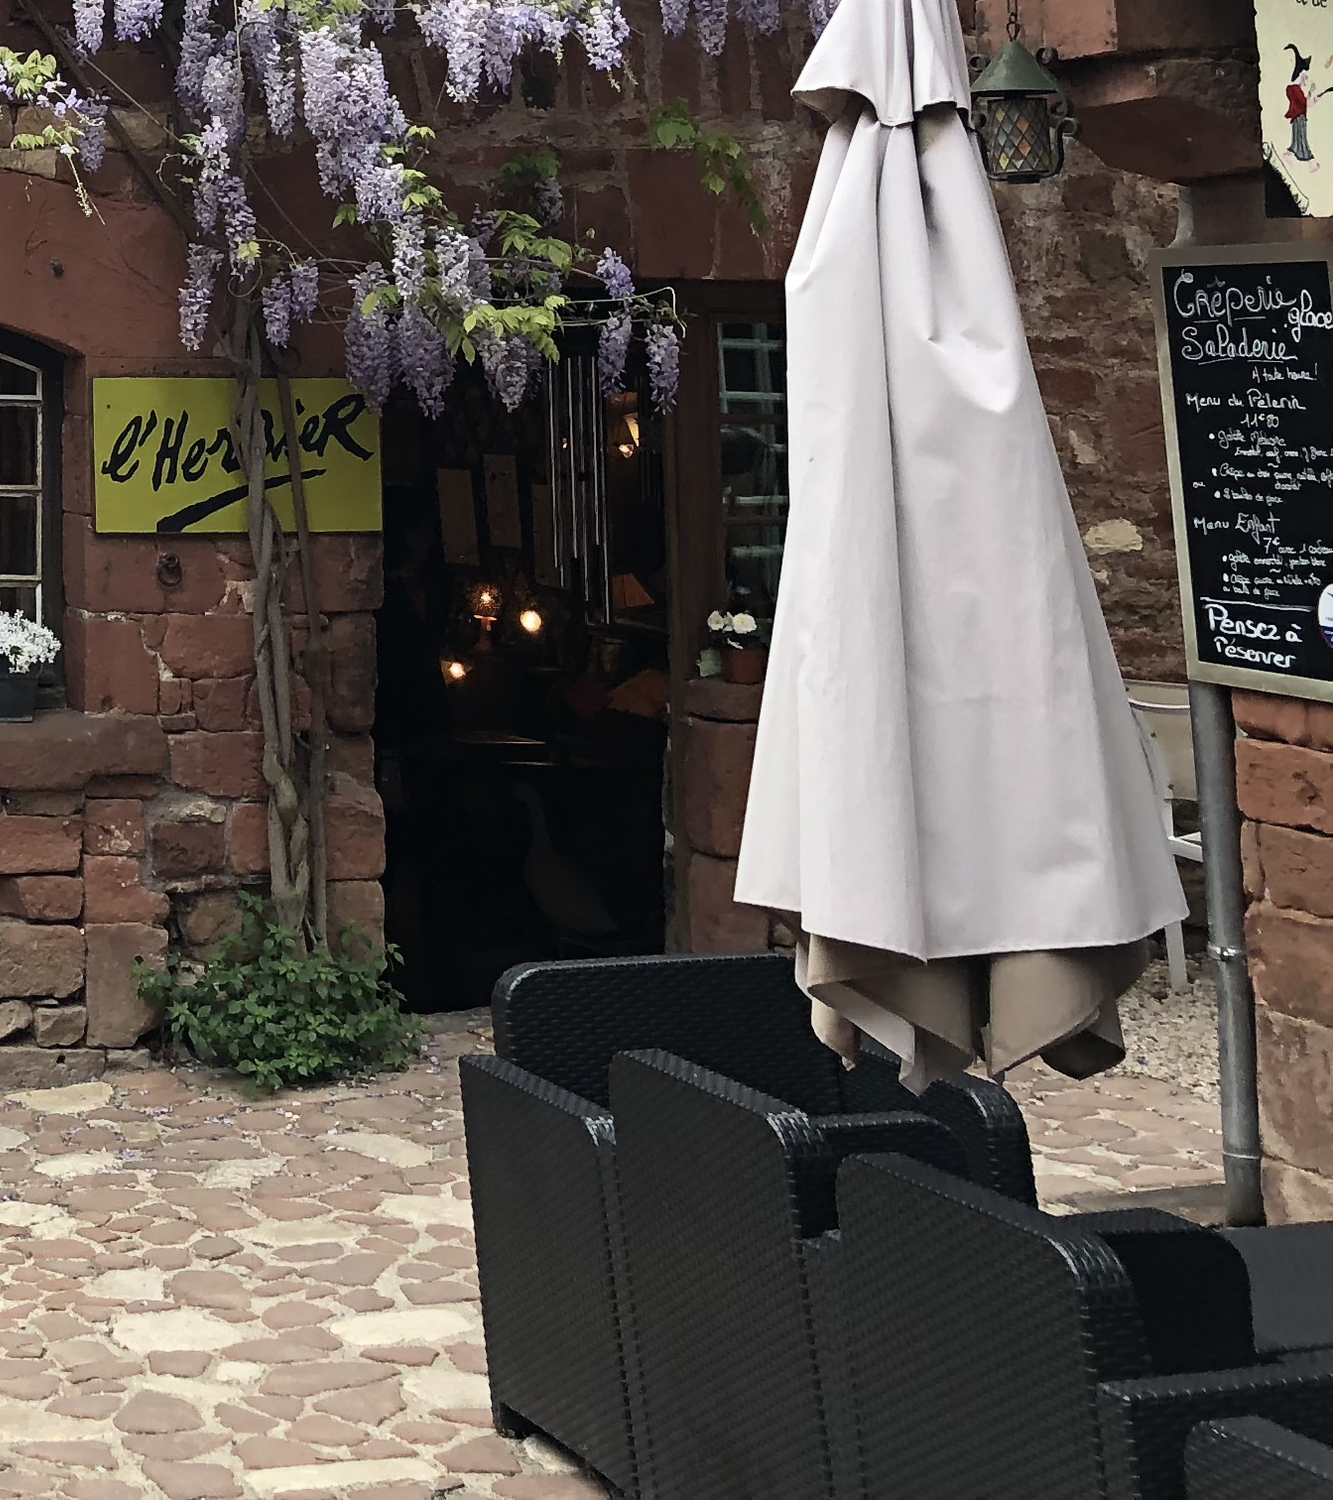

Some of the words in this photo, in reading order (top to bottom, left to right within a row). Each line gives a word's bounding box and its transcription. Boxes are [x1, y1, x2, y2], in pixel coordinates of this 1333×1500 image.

[1174, 269, 1297, 327] Crêperie
[1182, 324, 1298, 360] Saladerie
[1185, 392, 1221, 413] Menu
[1228, 393, 1244, 407] du
[1193, 516, 1229, 535] Menu
[1235, 511, 1281, 544] Enfant
[1202, 604, 1281, 640] Pensez
[1285, 623, 1303, 642] à
